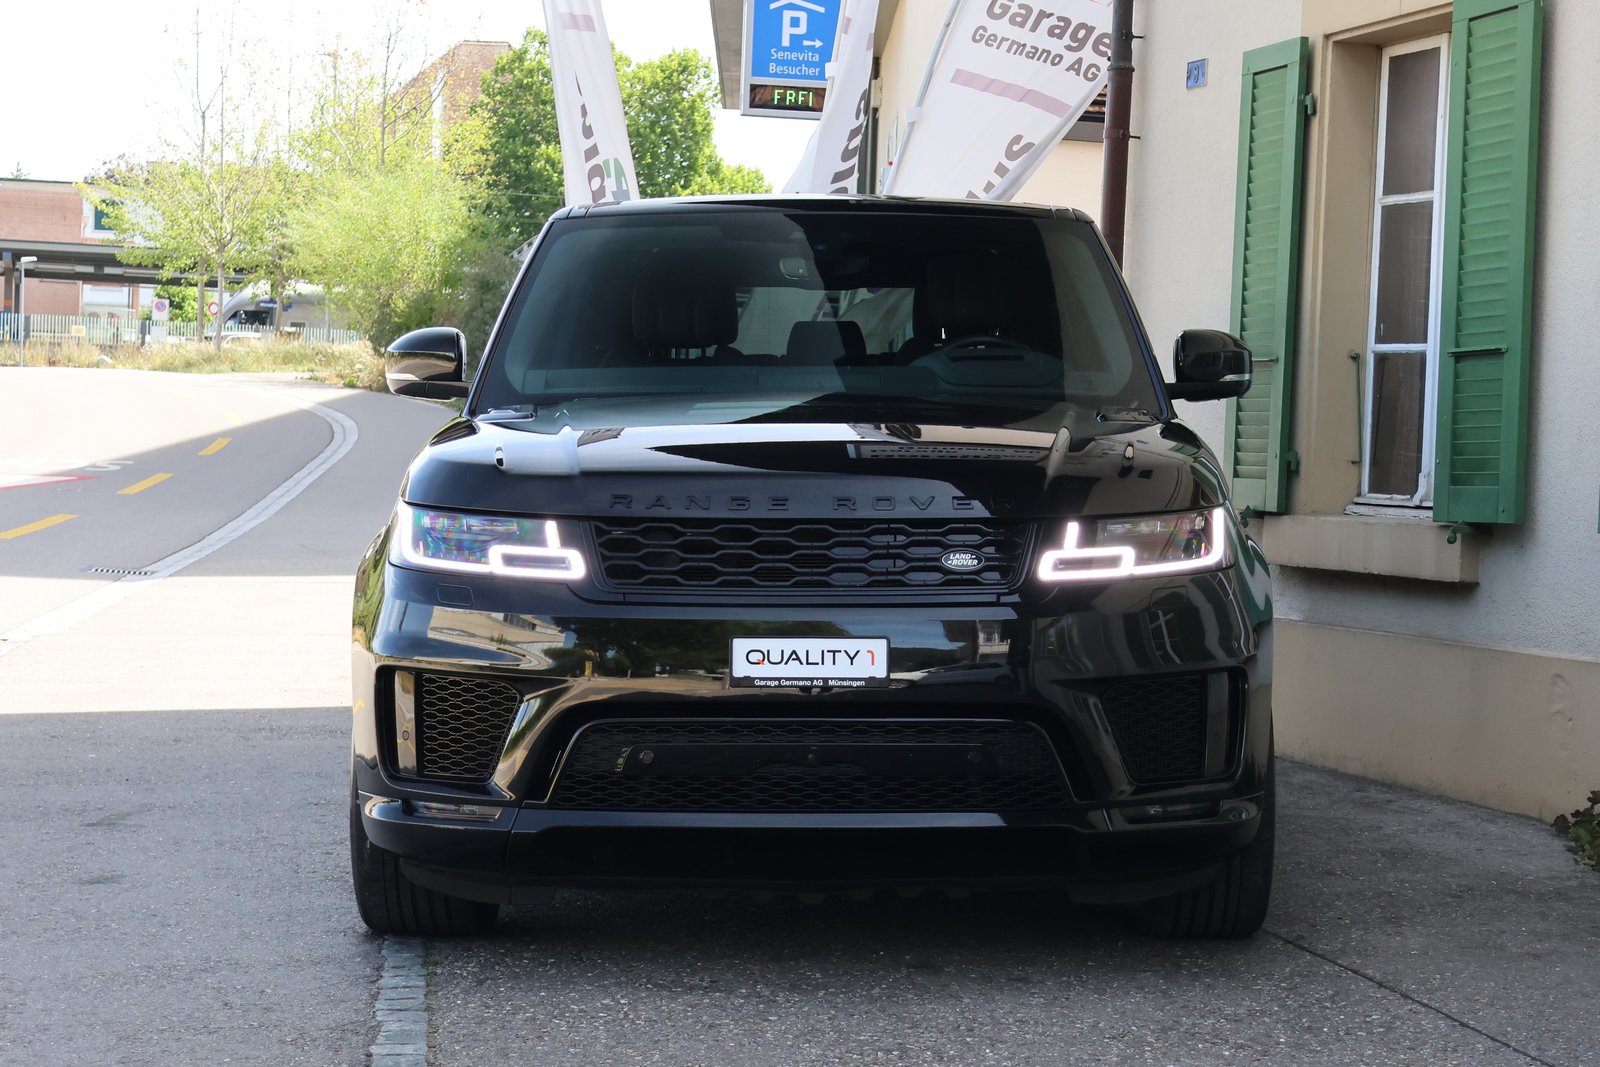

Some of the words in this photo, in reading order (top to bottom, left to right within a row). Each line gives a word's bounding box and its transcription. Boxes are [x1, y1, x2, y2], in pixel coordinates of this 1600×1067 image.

[781, 10, 808, 47] P
[771, 48, 820, 62] Senevita
[971, 25, 1064, 67] Germano
[1065, 56, 1101, 82] AG
[769, 63, 820, 76] Besucher
[609, 494, 789, 511] RANGE
[745, 649, 860, 666] QUALITY
[866, 649, 875, 666] 1
[754, 679, 779, 687] Garage
[828, 678, 865, 687] Münsingen
